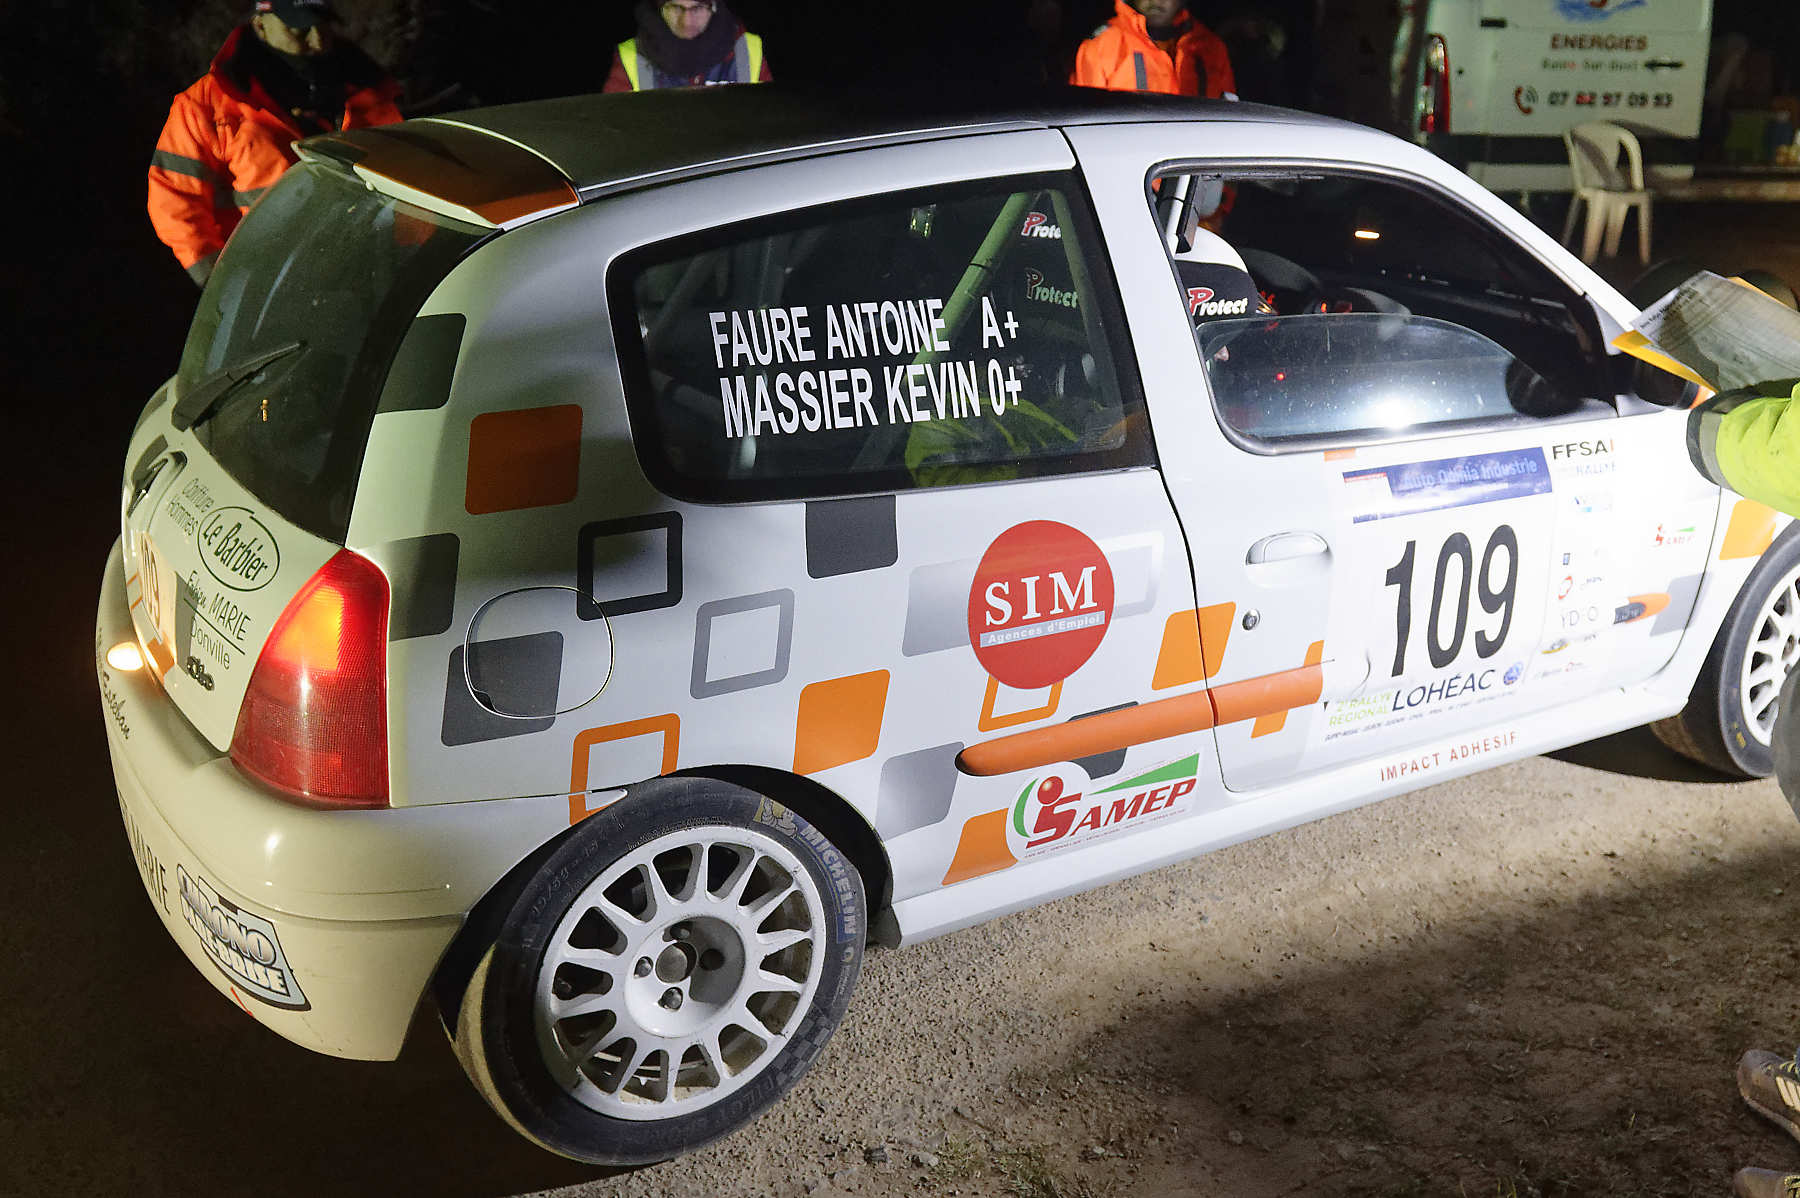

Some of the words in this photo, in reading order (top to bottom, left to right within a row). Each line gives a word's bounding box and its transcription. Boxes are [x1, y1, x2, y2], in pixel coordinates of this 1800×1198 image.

[1550, 33, 1648, 51] ENERGIES
[1025, 267, 1079, 309] Protect
[1187, 286, 1249, 317] Protect
[709, 306, 816, 369] FAURE
[826, 298, 950, 360] ANTOINE
[981, 296, 1020, 349] A+
[719, 367, 880, 438] MASSIER
[883, 360, 981, 424] KEVIN
[1481, 457, 1538, 480] Industrie
[1552, 439, 1608, 460] FFSA
[202, 513, 224, 546] Le
[214, 522, 268, 581] Barbier
[208, 592, 251, 641] MARIE
[985, 566, 1098, 627] SIM
[1385, 524, 1519, 678] 109
[988, 627, 1043, 645] Agences
[1047, 613, 1101, 634] d'Emploi
[1391, 669, 1496, 712] LOHÉAC
[1380, 752, 1441, 782] IMPACT
[1449, 731, 1517, 762] ADHESIF
[1025, 778, 1197, 849] SAMEP
[801, 823, 857, 936] MICHELIN
